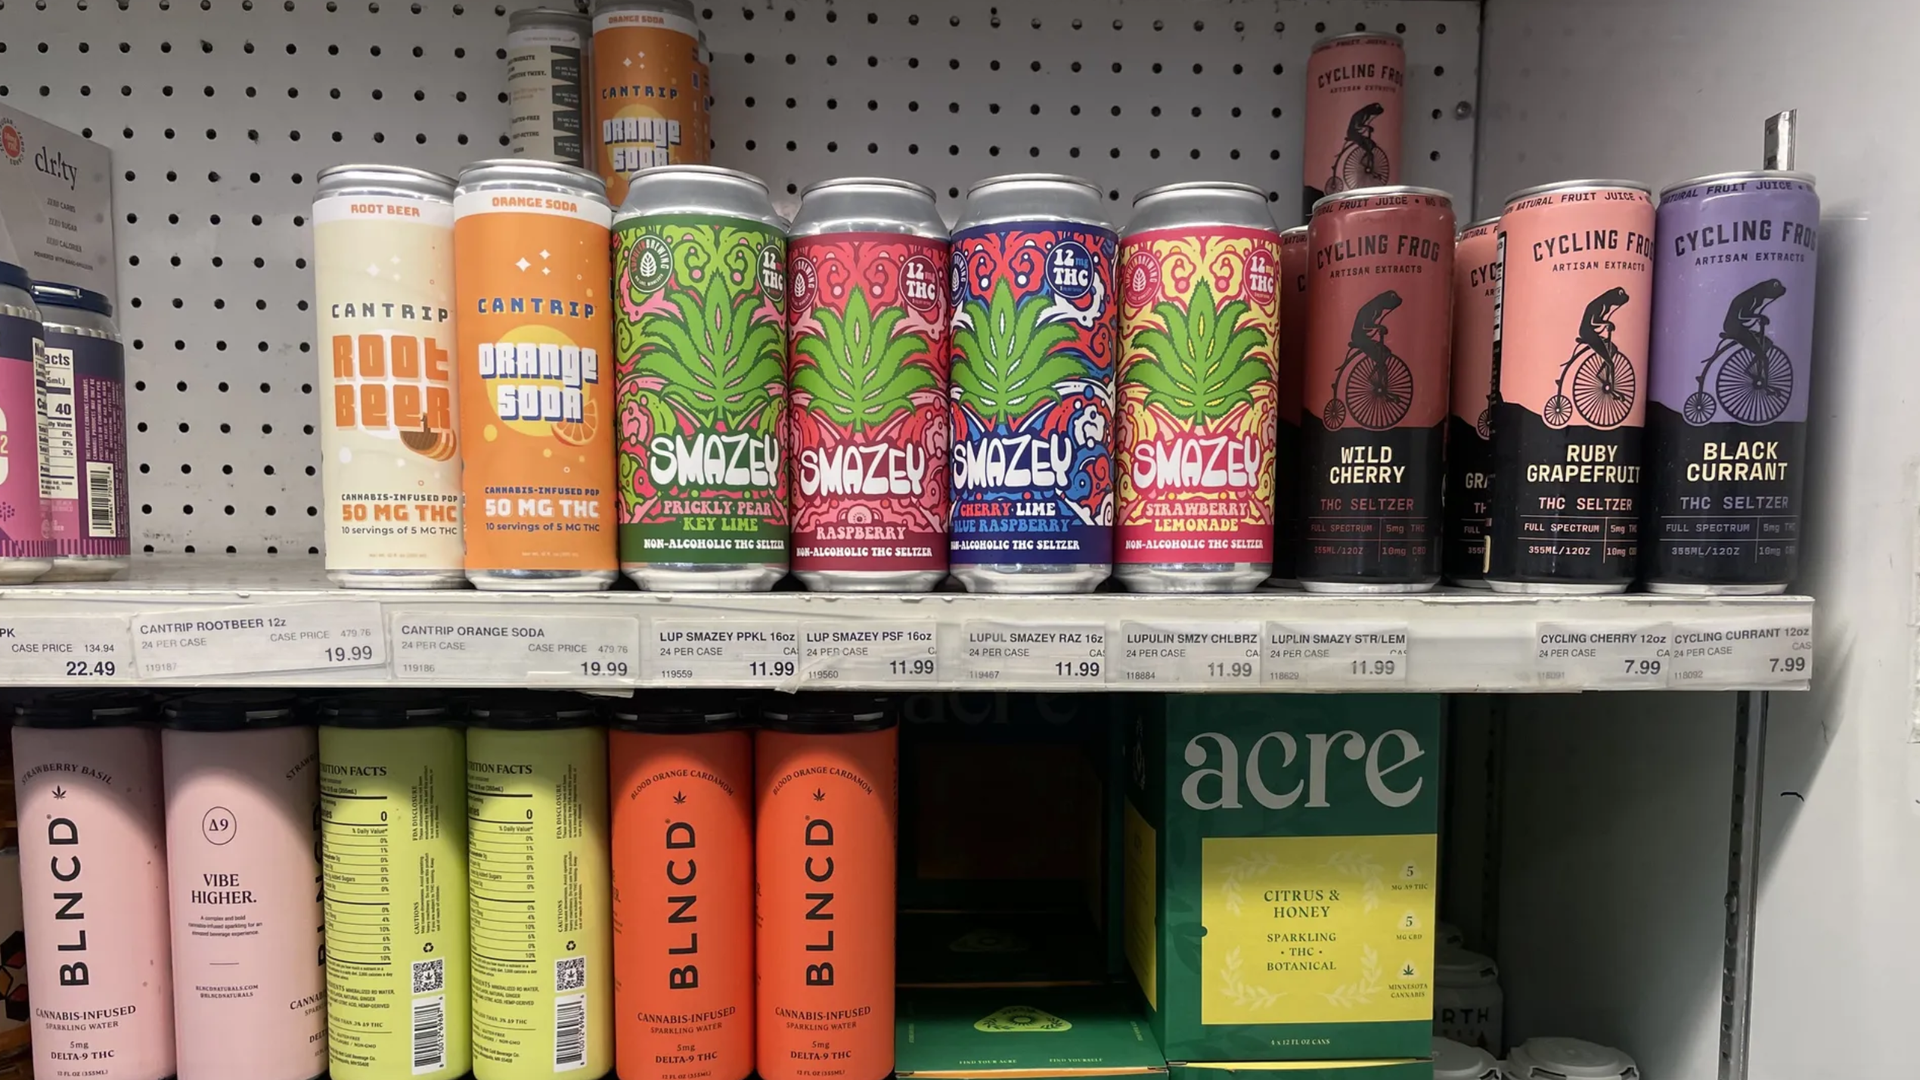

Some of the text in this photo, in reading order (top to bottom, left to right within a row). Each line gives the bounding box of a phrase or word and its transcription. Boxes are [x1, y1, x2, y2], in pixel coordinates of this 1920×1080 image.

[608, 15, 665, 24] ORANGE SODA
[1318, 64, 1375, 88] CYCLING
[602, 85, 679, 100] CANTRIP
[351, 204, 420, 217] ROOT BEER
[492, 197, 578, 213] ORANGE SODA
[1675, 219, 1817, 257] CYCLING FROG
[1317, 234, 1440, 270] CYCLING FROG
[1533, 229, 1618, 263] CYCLING
[1054, 249, 1089, 268] 12 mg
[1330, 265, 1422, 279] ARTISAN EXTRACTS
[1552, 261, 1645, 272] ARTISAN EXTRACTS
[1053, 267, 1089, 287] THC
[332, 303, 448, 321] CANTRIP
[478, 298, 595, 318] CANTRIP
[55, 403, 72, 416] 40
[1341, 446, 1392, 464] WILD
[1566, 444, 1618, 462] RUBY
[1703, 441, 1779, 460] BLACK
[650, 432, 780, 487] SMAZEY
[953, 433, 1073, 490] SMAZEY
[1134, 434, 1260, 489] SMAZEY
[801, 443, 926, 496] SMAZEY
[1330, 466, 1406, 484] CHERRY
[1526, 465, 1641, 483] GRAPEFRUIT
[1686, 462, 1788, 482] CURRANT
[341, 493, 458, 503] CANNABIS-INFUSED POP
[1320, 498, 1414, 511] THC SELTZER
[1538, 497, 1633, 511] THC SELTZER
[342, 504, 458, 523] 50 MG THC
[663, 500, 772, 516] PRICKLY PEAR
[960, 502, 1056, 517] CHERRY LIME
[1145, 503, 1247, 516] STRAWBERRY
[341, 525, 457, 536] 10 servings of 5 MG THC
[683, 518, 758, 532] KEY LIME
[978, 519, 1070, 533] RASPBERRY
[1154, 518, 1239, 532] LEMONADE
[1524, 523, 1600, 533] FULL SPECTRUM
[816, 526, 906, 540] RASPBERRY
[644, 539, 785, 550] NON-ALCOHOLIC THC SELTZER
[1528, 546, 1591, 555] 355ML/12OZ
[140, 618, 287, 635] CANTRIP ROOTBEER 12z
[401, 626, 545, 638] CANTRIP ORANGE SODA
[660, 632, 796, 642] LUP SMAZEY PPKL 16oz
[806, 631, 932, 642] LUP SMAZEY PSF 16oz
[970, 633, 1103, 644] LUPUL SMAZEY RAZ 16z
[1127, 634, 1258, 644] LUPULIN SMZY CHLBRZ
[1271, 634, 1406, 644] LUPLIN SMAZY STR/LEM
[1541, 634, 1667, 644] CYCLING CHERRY 12oz
[1674, 627, 1810, 645] CYCLING CURRANT 12oz
[12, 644, 115, 653] CASE PRICE 134.94
[141, 638, 207, 649] 24 PER CASE
[325, 646, 373, 662] 19.99
[66, 661, 116, 676] 22.49
[403, 664, 435, 672] 119186
[580, 661, 628, 676] 19.99
[750, 661, 795, 677] 11.99
[889, 660, 934, 674] 11.99
[1055, 661, 1100, 677] 11.99
[1207, 662, 1252, 677] 11.99
[1350, 660, 1395, 675] 11.99
[1624, 660, 1661, 675] 7.99
[1769, 657, 1806, 673] 7.99
[661, 670, 693, 678] 119559
[1674, 670, 1703, 679] 118092
[20, 763, 113, 786] STRAWBERRY BASIL
[350, 766, 387, 776] FACTS
[496, 764, 533, 774] FACTS
[1181, 728, 1425, 811] acre
[630, 769, 735, 800] BLOOD ORANGE CARDAMOM
[203, 874, 240, 888] VIBE
[48, 817, 90, 986] BLNCD
[191, 890, 257, 905] HIGHER.
[1264, 890, 1341, 902] CITRUS &
[666, 821, 699, 990] BLNCD
[1273, 906, 1331, 919] HONEY
[1406, 917, 1413, 927] 5
[1267, 933, 1337, 943] SPARKLING
[1289, 947, 1315, 957] THC
[1266, 961, 1337, 972] BOTANICAL
[1388, 983, 1429, 991] MINNESOTA
[1391, 991, 1426, 999] CANNABIS
[36, 1005, 137, 1021] CANNABIS-INFUSED
